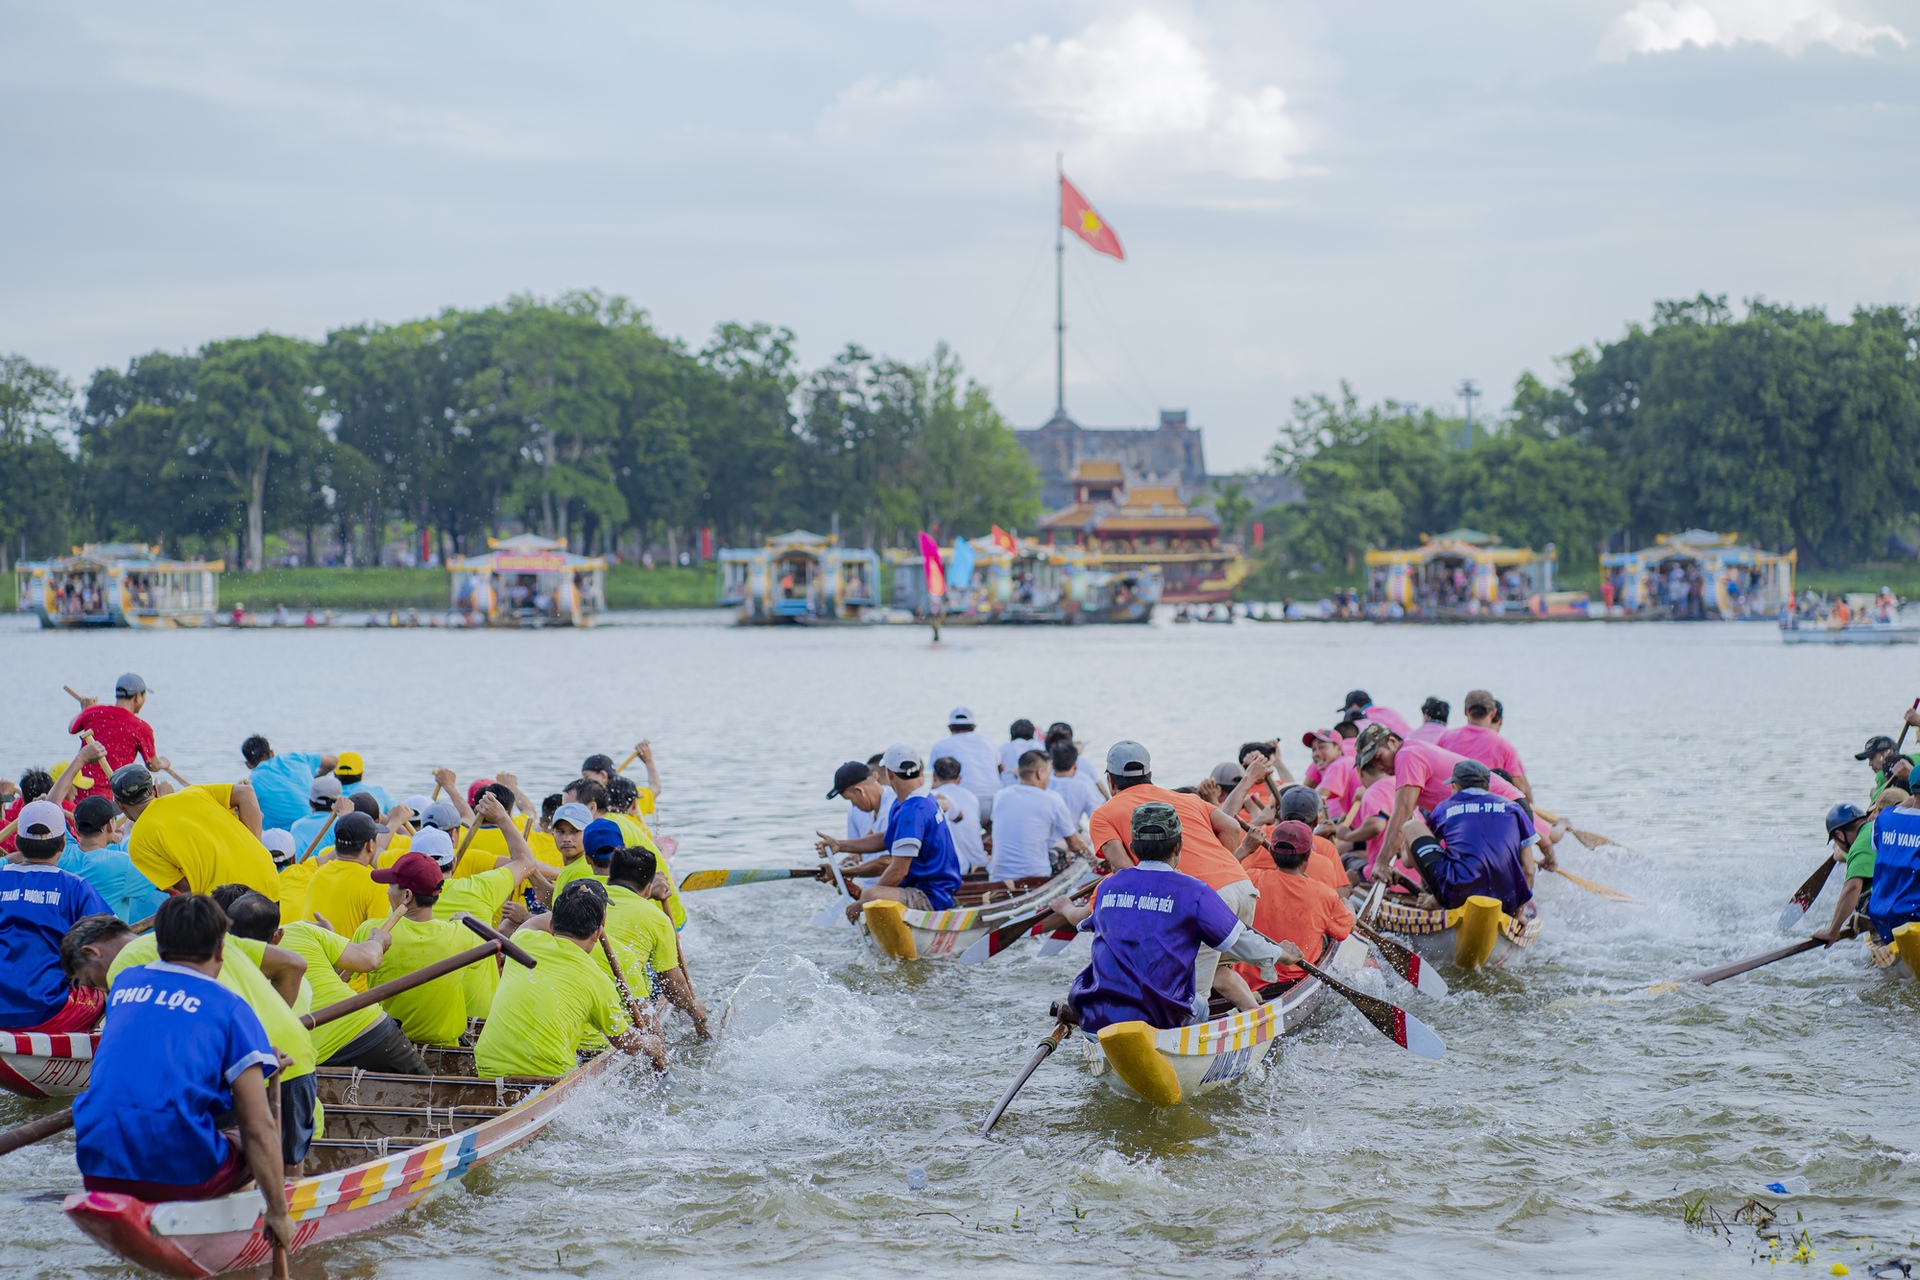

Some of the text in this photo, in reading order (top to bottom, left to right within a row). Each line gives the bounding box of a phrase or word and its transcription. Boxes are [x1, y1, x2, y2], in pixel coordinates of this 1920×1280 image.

[1483, 802, 1493, 813] TP
[1882, 829, 1920, 848] PHÚ VANG
[1137, 892, 1159, 911] QUẢNG
[111, 984, 201, 1013] PHÚ LỘC
